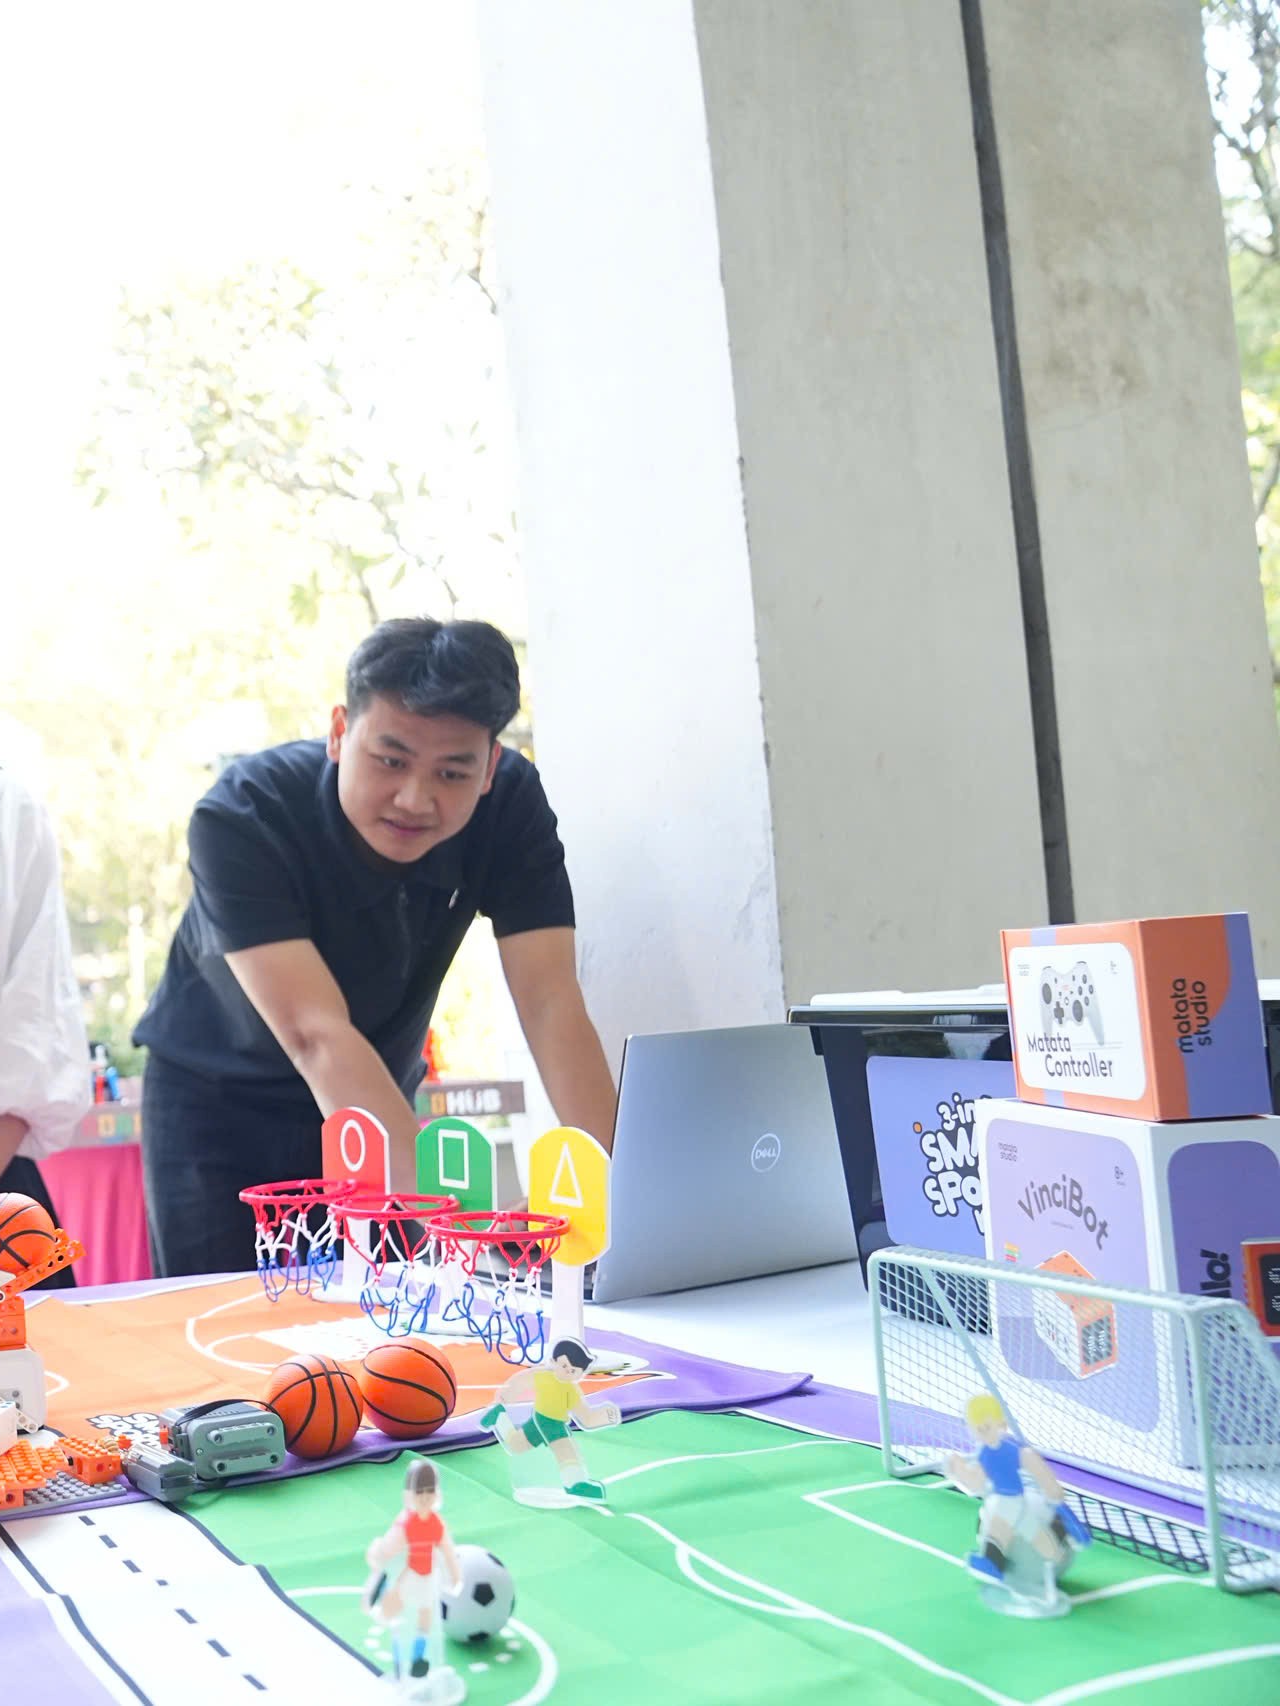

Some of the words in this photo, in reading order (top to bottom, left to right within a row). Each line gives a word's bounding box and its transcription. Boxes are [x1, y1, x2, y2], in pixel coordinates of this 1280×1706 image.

[1026, 1031, 1072, 1053] Matata
[1169, 977, 1195, 1054] matata
[1189, 980, 1213, 1047] studio
[1044, 1051, 1113, 1078] Controller
[1017, 1172, 1109, 1251] VinciBot
